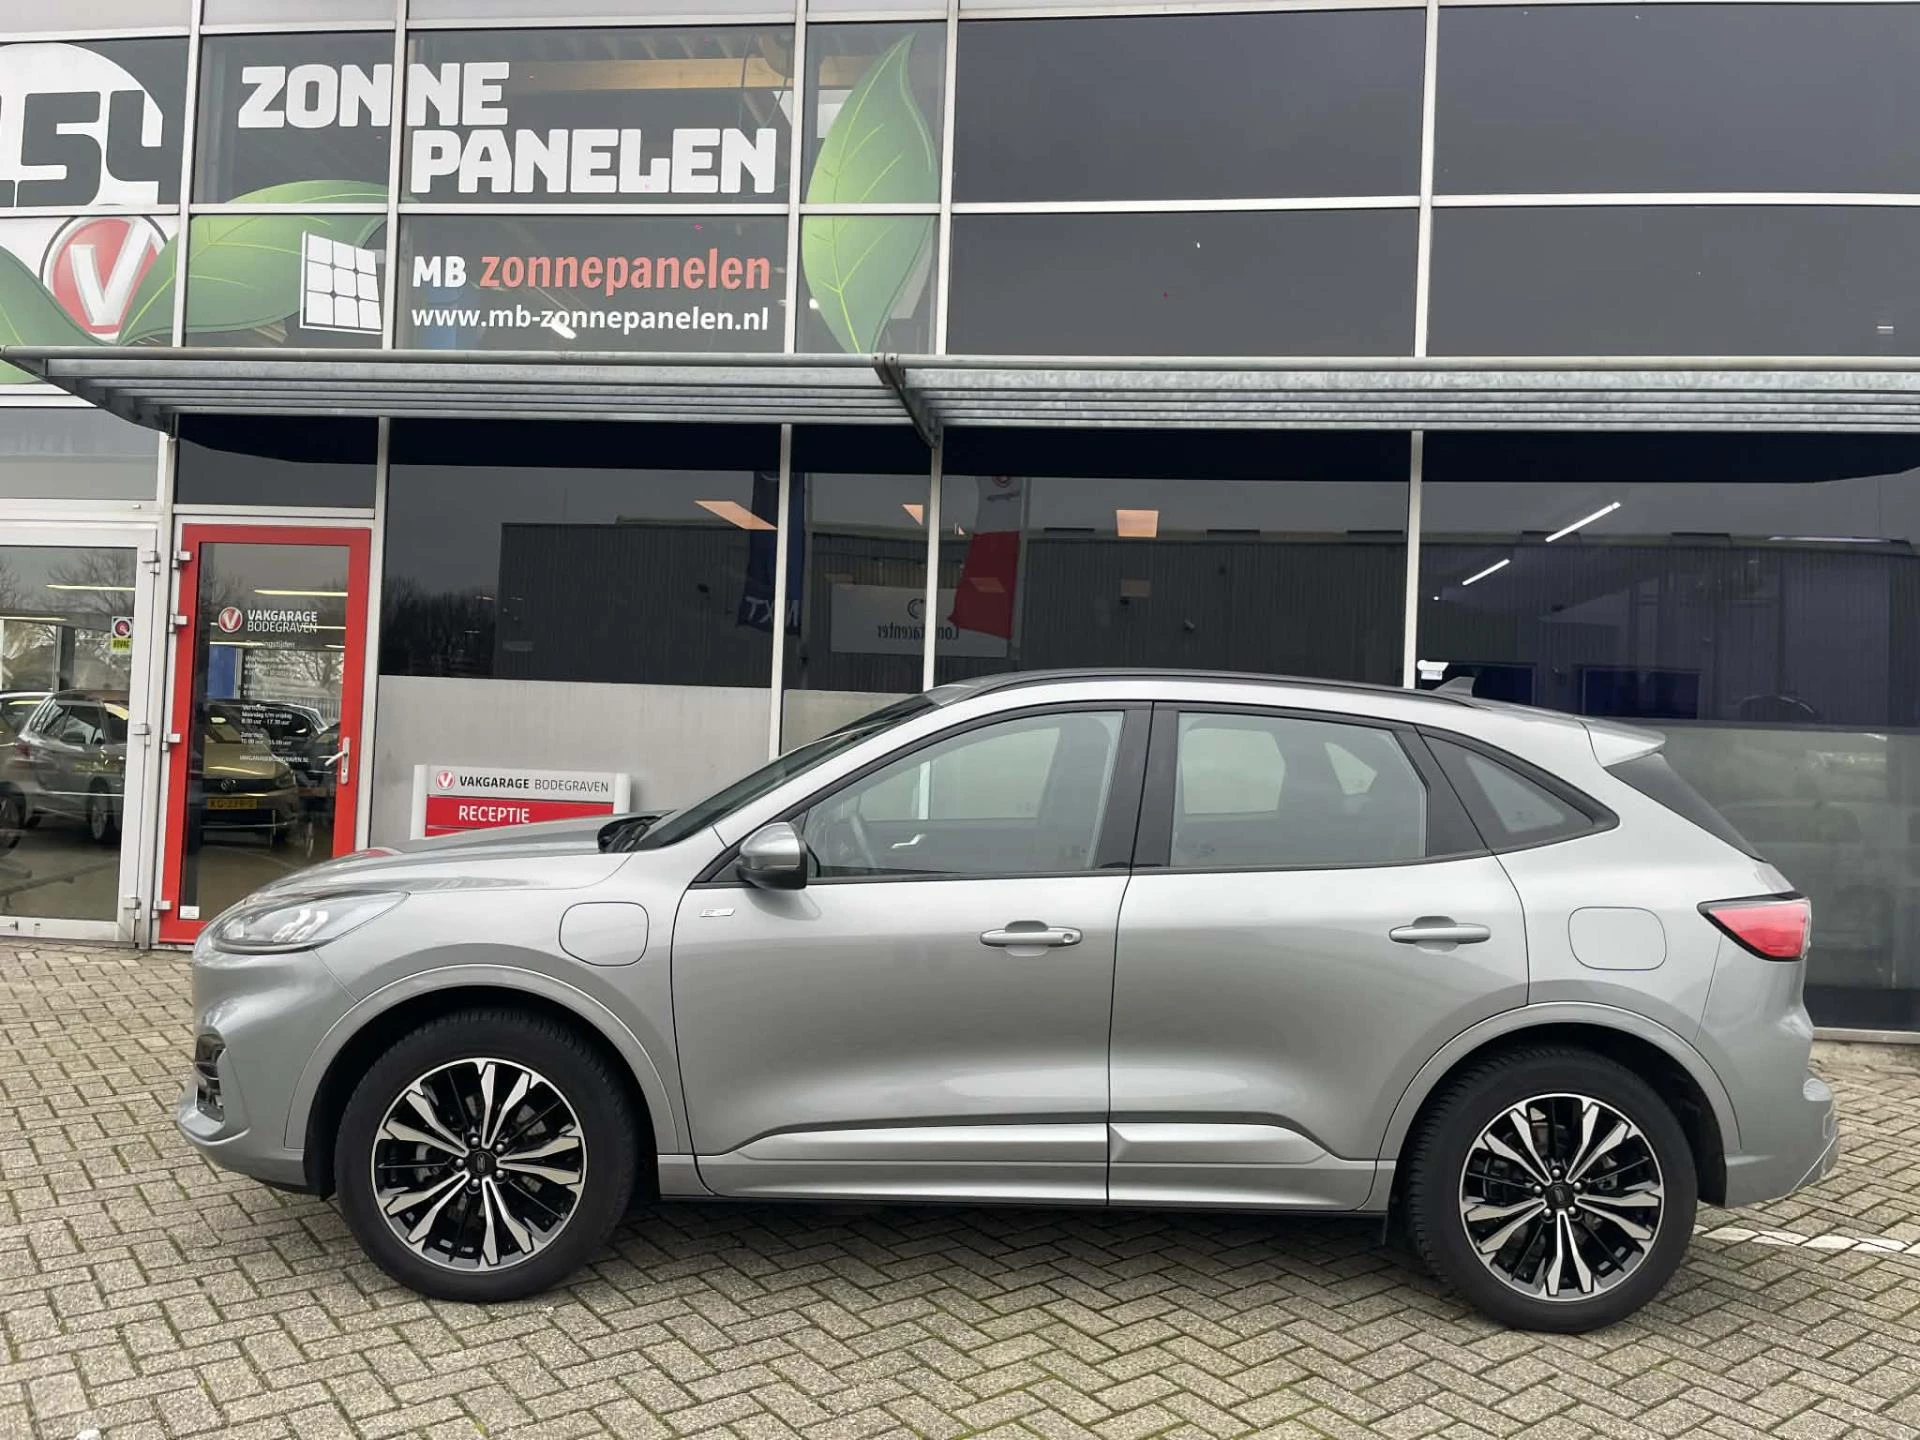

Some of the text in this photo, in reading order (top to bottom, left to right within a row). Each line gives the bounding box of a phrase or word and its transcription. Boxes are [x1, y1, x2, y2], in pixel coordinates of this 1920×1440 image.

[238, 62, 509, 129] ZONNE
[410, 128, 777, 194] PANELEN
[412, 248, 770, 297] MB zonnepanelen
[411, 304, 769, 335] www.mb-zonnepanelen.nl
[247, 609, 318, 622] VAKGARAGE
[247, 620, 318, 634] BODEGRAVEN
[459, 775, 609, 793] VAKGARAGE BODEGRAVEN
[458, 804, 530, 824] RECEPTIE
